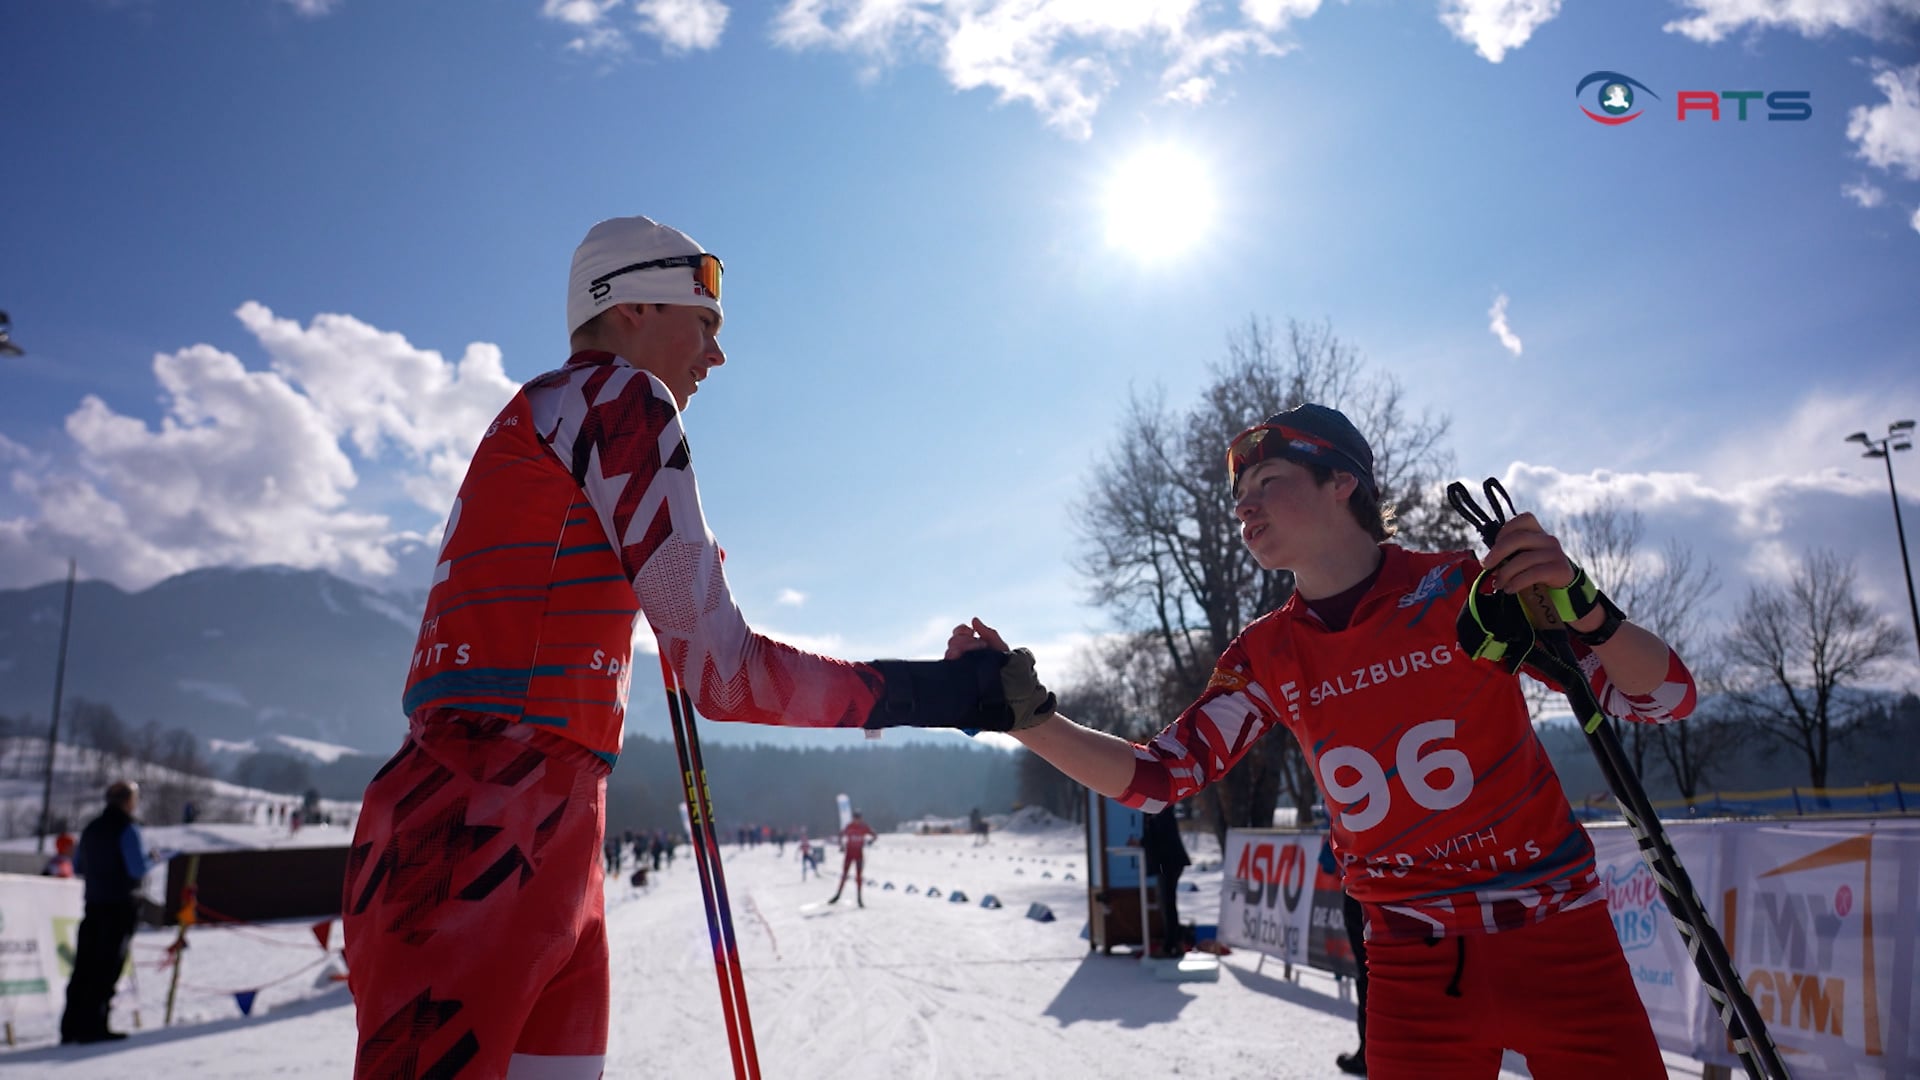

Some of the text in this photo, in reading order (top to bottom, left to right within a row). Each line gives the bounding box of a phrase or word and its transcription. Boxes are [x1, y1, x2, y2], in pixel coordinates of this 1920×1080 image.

[1310, 645, 1452, 705] SALZBURG
[1319, 719, 1474, 832] 96
[1424, 827, 1498, 860] WITH
[1753, 890, 1842, 972] MY
[1749, 968, 1845, 1036] GYM
